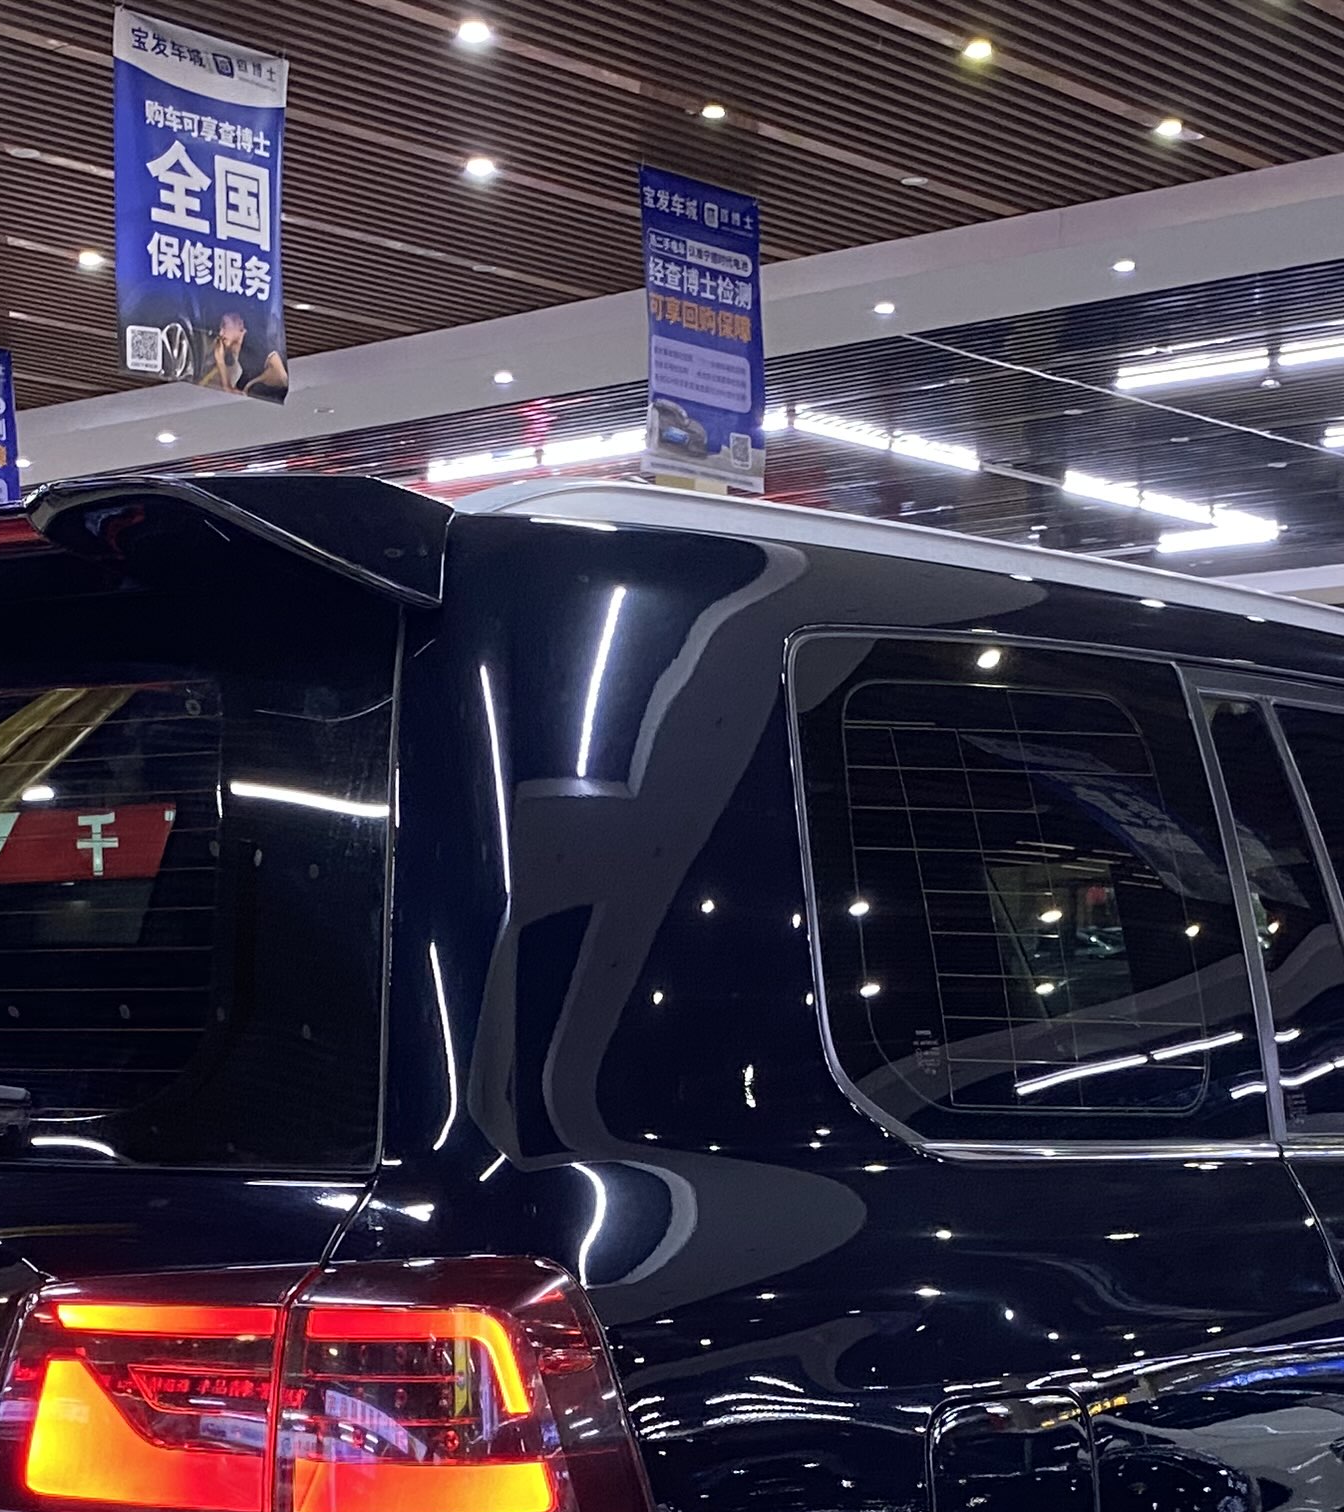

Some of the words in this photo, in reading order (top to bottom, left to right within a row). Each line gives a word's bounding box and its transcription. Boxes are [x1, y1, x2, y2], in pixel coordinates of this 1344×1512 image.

[131, 27, 206, 69] 宝发车城
[145, 100, 271, 157] 购车可享查博士
[146, 140, 271, 252] 全国
[147, 231, 272, 301] 保修服务
[649, 256, 752, 310] 经查博士检测
[649, 292, 752, 343] 可享回购保障
